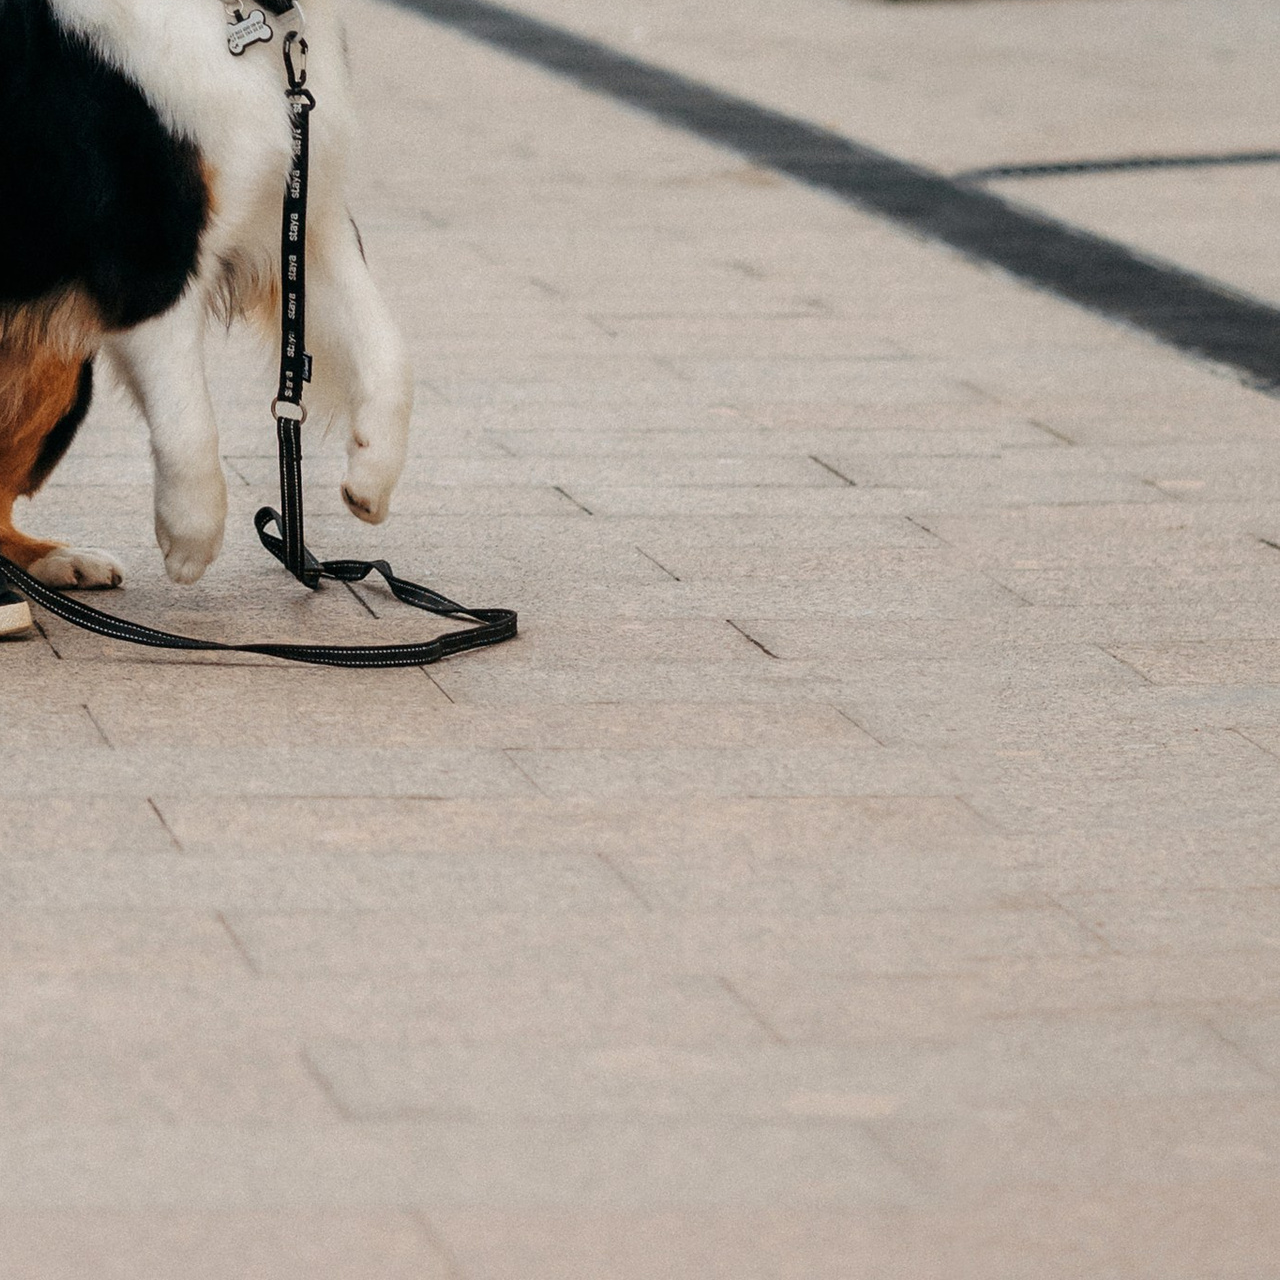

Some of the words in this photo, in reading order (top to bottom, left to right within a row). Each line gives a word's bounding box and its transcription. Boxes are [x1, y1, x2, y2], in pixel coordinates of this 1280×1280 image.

[290, 169, 302, 199] staya
[288, 213, 300, 242] staya
[287, 254, 298, 281] staya
[287, 292, 297, 320] staya
[286, 331, 297, 358] sty
[285, 371, 294, 398] saa
